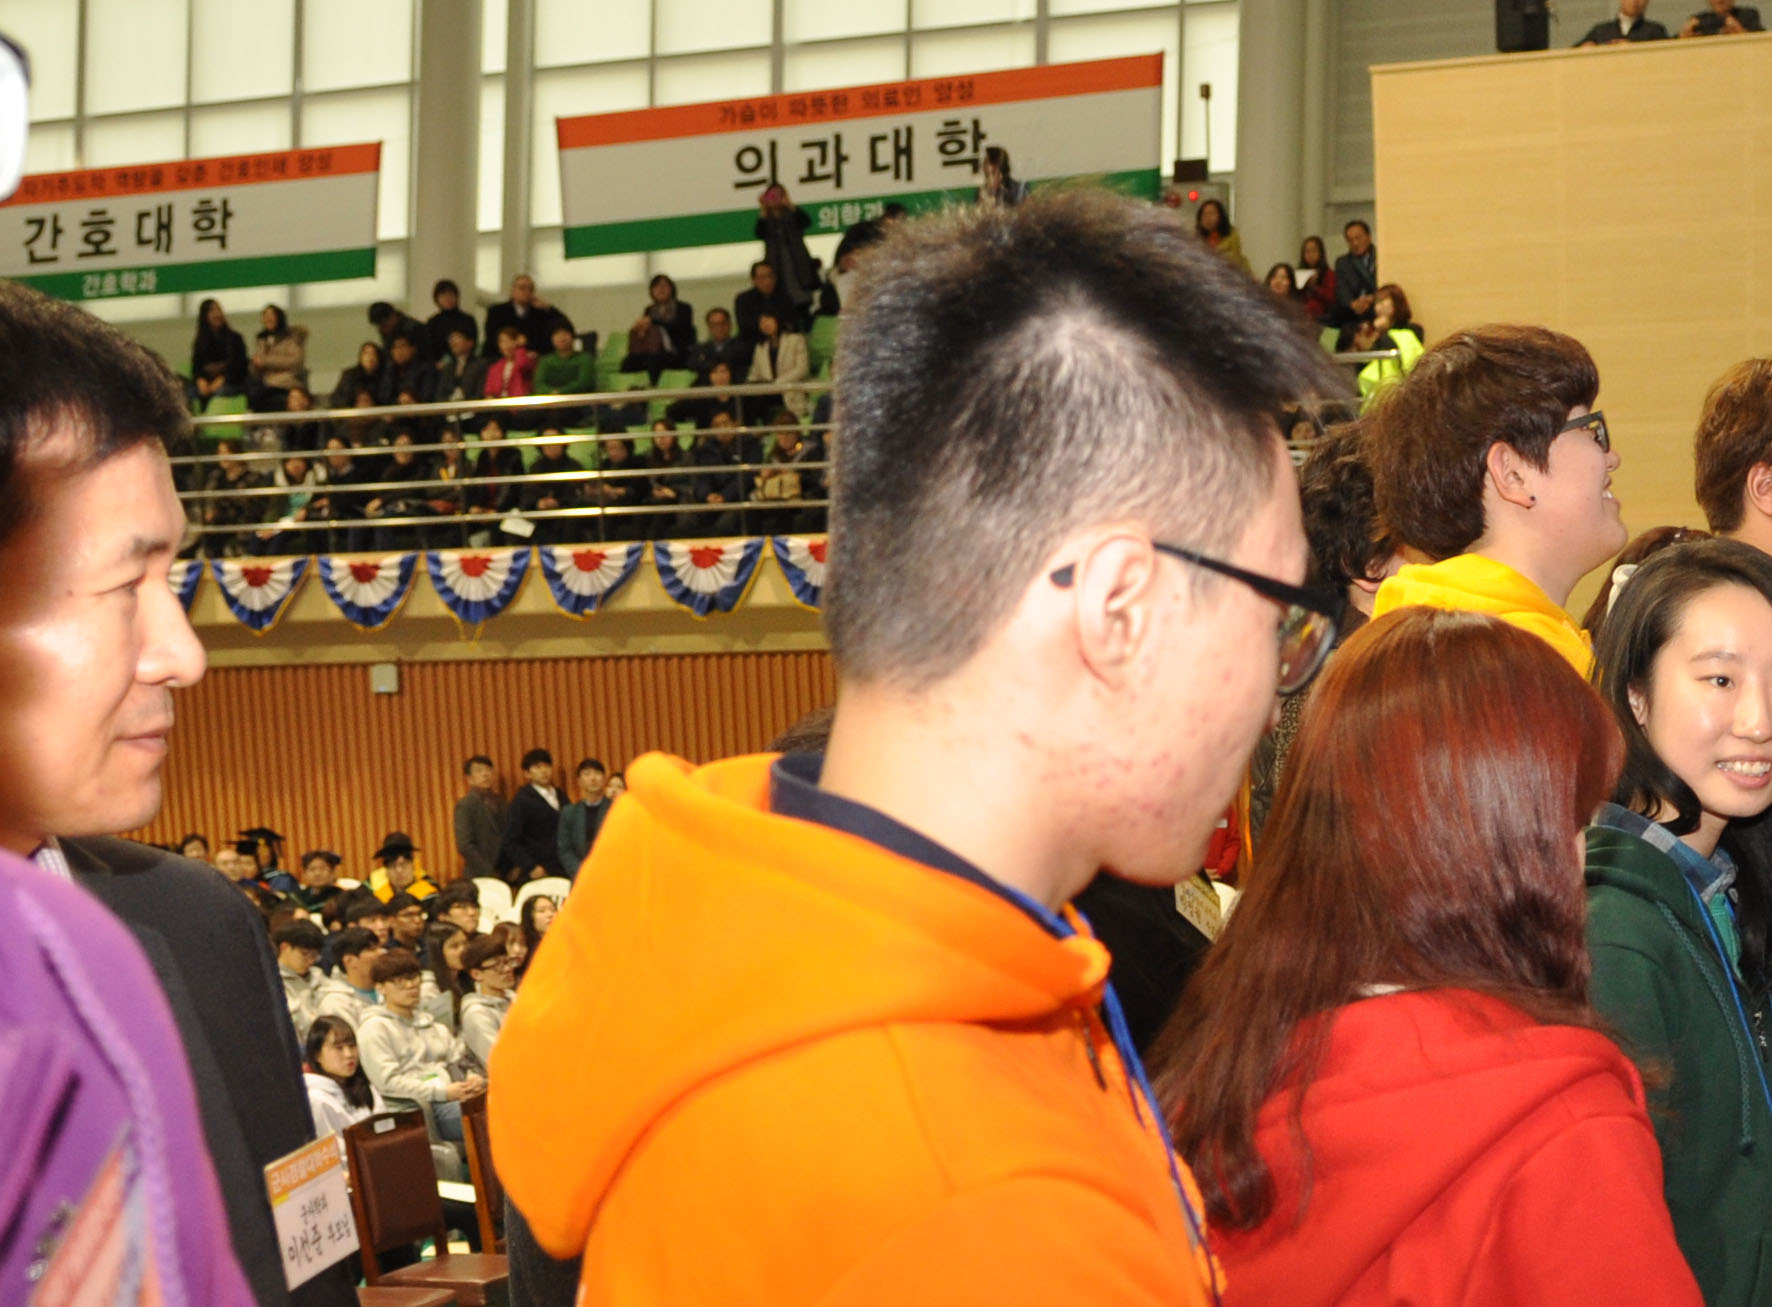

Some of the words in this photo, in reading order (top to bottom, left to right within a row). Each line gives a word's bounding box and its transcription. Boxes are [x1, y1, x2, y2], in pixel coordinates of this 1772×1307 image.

[719, 102, 778, 125] 가슴이
[790, 94, 848, 117] 따뜻한
[934, 80, 974, 103] 양성
[734, 119, 987, 190] 의과대학
[22, 198, 234, 265] 간호대학
[82, 271, 158, 298] 간호학과
